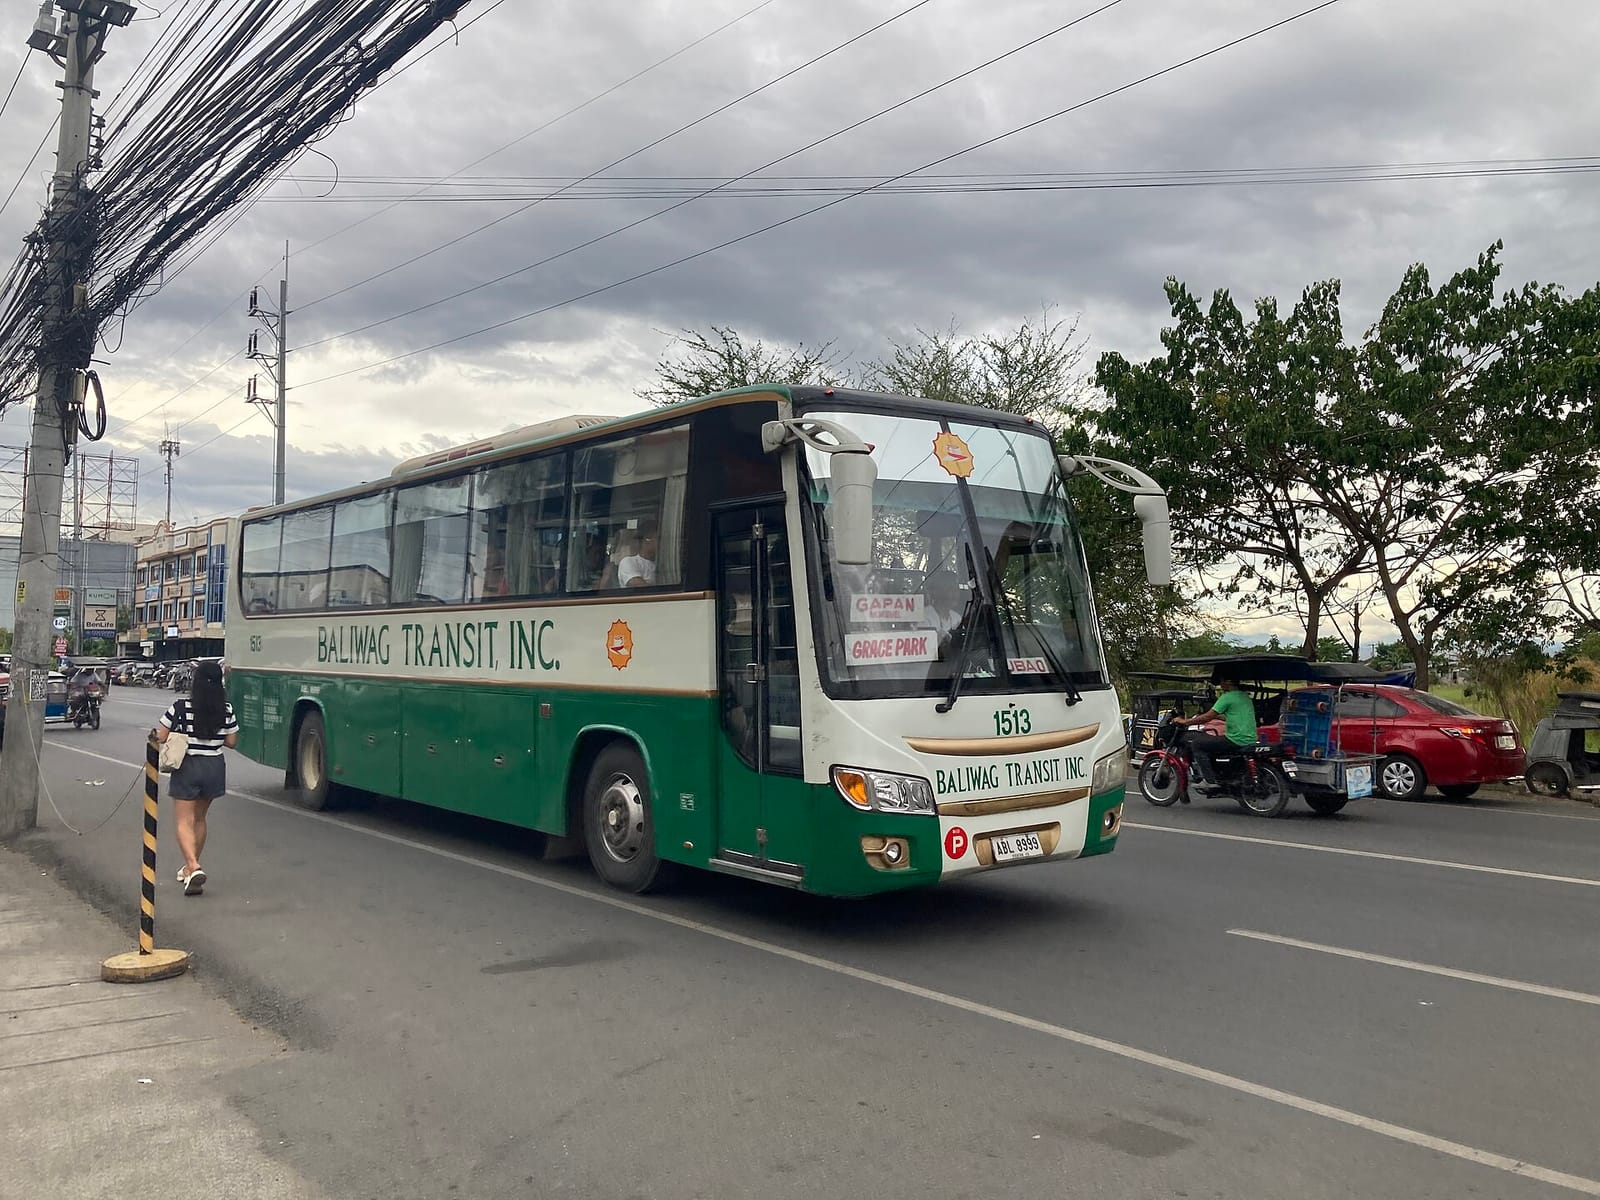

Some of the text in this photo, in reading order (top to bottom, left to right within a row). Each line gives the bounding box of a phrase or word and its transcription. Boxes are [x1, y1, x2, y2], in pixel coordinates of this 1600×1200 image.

[856, 597, 915, 613] GAPAN
[317, 619, 560, 671] BALIWAG TRANSIT, INC.
[852, 636, 928, 659] GRACE PARK
[993, 708, 1032, 736] 1513
[936, 756, 1088, 795] BALIWAG TRANSIT INC.
[952, 835, 964, 854] P
[996, 836, 1039, 856] ABL 8999
